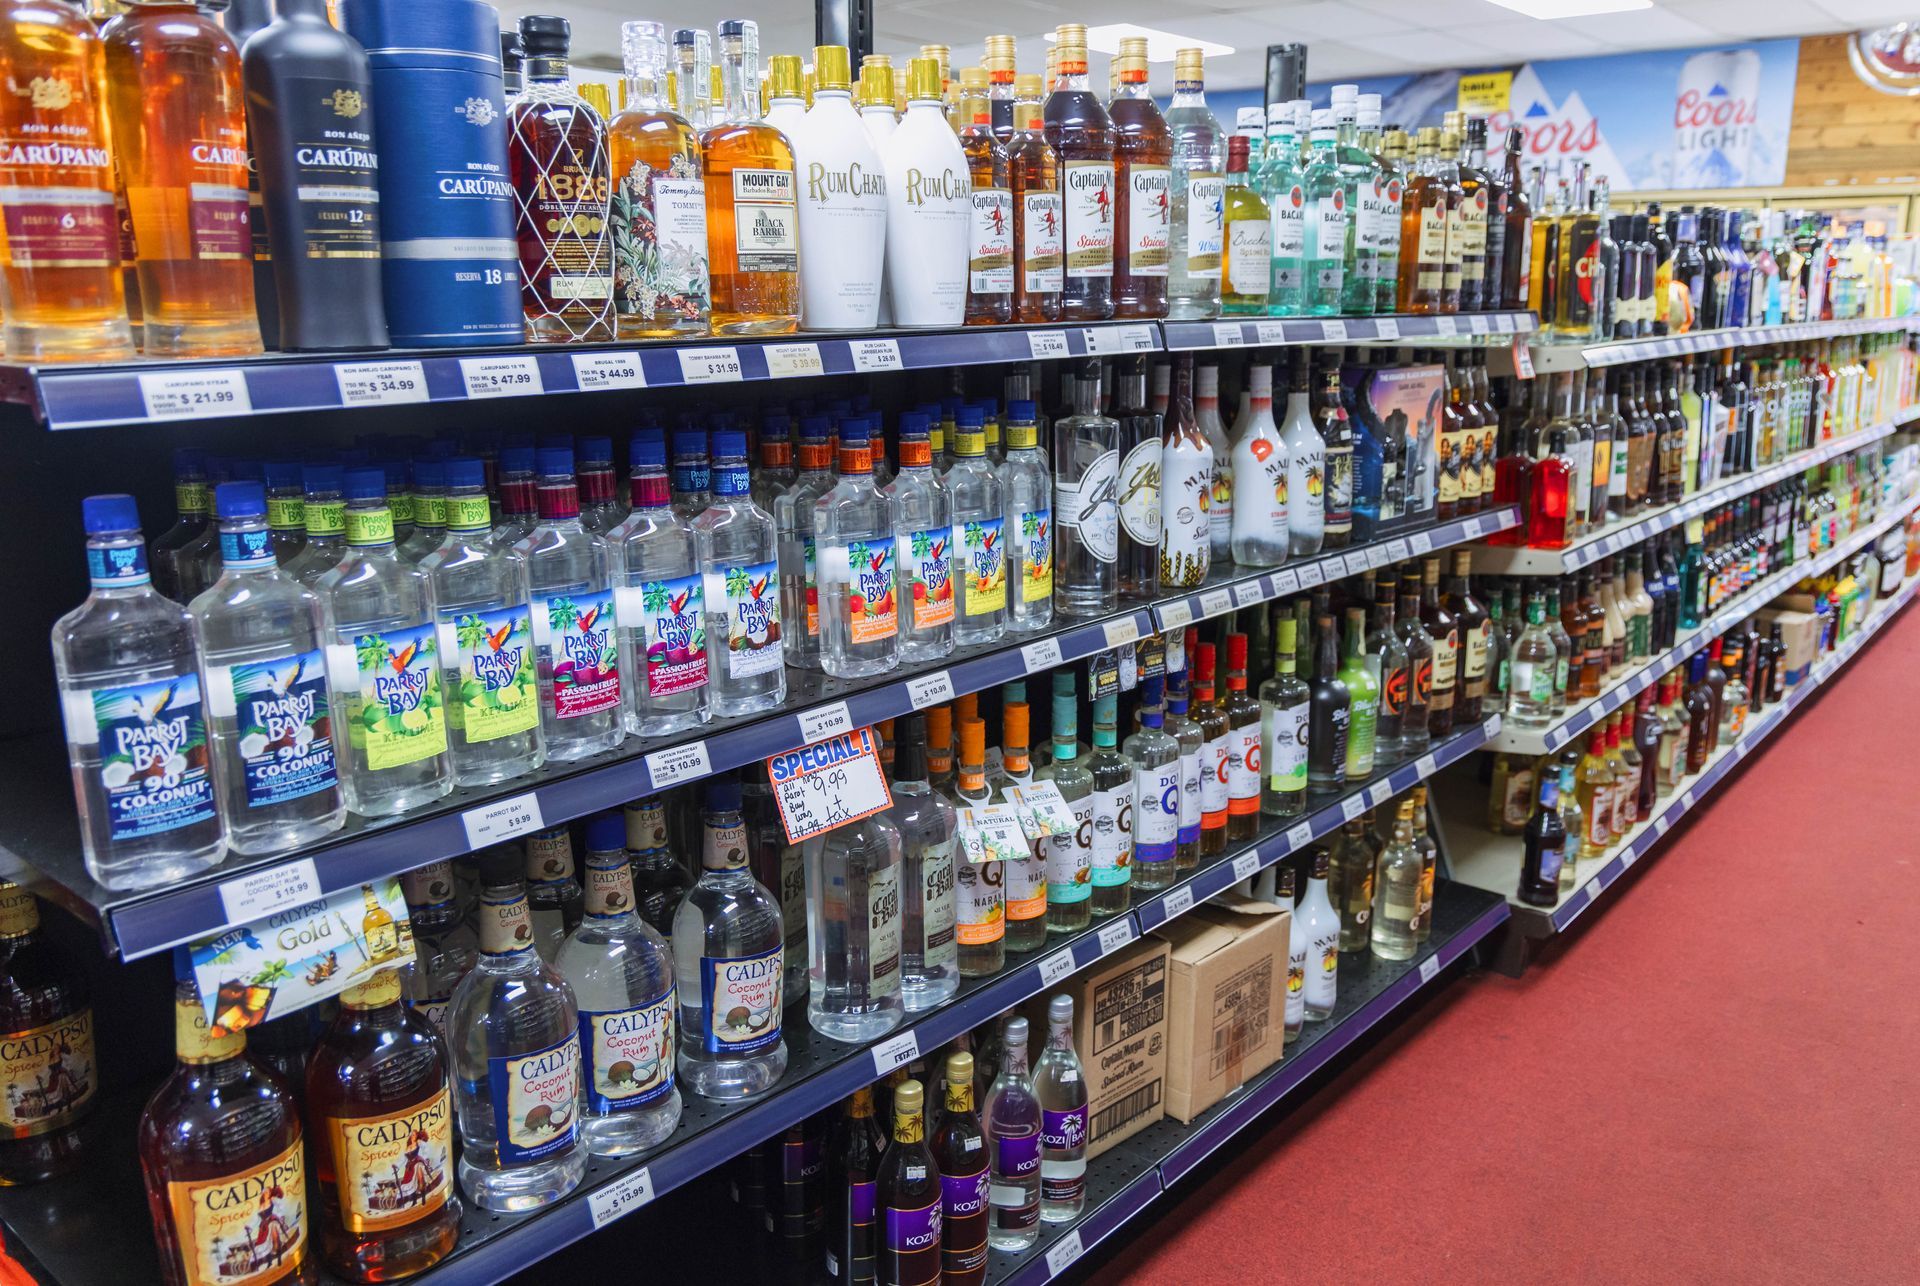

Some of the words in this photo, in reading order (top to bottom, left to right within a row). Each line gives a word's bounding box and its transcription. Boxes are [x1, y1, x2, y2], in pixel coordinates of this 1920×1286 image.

[1673, 88, 1757, 129] Coors
[1678, 126, 1750, 150] LIGHT
[440, 176, 513, 198] CARÚPANO
[535, 174, 609, 201] 1888
[742, 174, 774, 187] MOUNT
[776, 174, 789, 188] GAY
[1070, 170, 1105, 190] Captain
[1134, 174, 1165, 192] Captain
[658, 184, 689, 199] Tommy
[742, 186, 766, 194] Barbados
[1192, 180, 1222, 200] Captain
[972, 194, 998, 210] Captain
[1028, 196, 1050, 212] Captain
[61, 212, 76, 229] 6
[349, 210, 364, 224] 12
[755, 218, 785, 228] BLACK
[752, 227, 788, 237] BARREL
[1077, 234, 1108, 248] Spiced
[979, 244, 1002, 256] Spiced
[1034, 245, 1055, 256] Spiced
[1140, 235, 1167, 248] Spiced
[456, 272, 481, 282] RESERVA
[484, 269, 502, 285] 18
[556, 279, 574, 288] RUM
[1049, 342, 1063, 350] 18.49
[800, 358, 820, 368] 39.99
[882, 354, 896, 362] 26.99
[608, 368, 634, 378] 44.99
[716, 362, 738, 374] 31.99
[381, 380, 414, 391] 34.99
[500, 374, 531, 384] 47.99
[194, 391, 234, 404] 21.99
[460, 500, 488, 516] PARROT
[467, 508, 486, 522] BAY
[361, 513, 392, 530] PARROT
[368, 523, 388, 537] BAY
[974, 548, 1002, 569] PARROT
[1035, 550, 1048, 566] BAY
[922, 556, 950, 580] PARROT
[980, 560, 998, 578] BAY
[860, 568, 892, 592] PARROT
[928, 572, 948, 591] BAY
[867, 584, 887, 603] BAY
[738, 596, 774, 622] PARROT
[926, 598, 950, 610] MANGO
[657, 610, 698, 638] PARROT
[747, 614, 772, 635] BAY
[864, 612, 891, 624] MANGO
[564, 628, 609, 658] PARROT
[666, 627, 694, 652] BAY
[473, 646, 524, 682] PARROT
[574, 646, 606, 671] BAY
[654, 662, 689, 676] PASSION
[689, 659, 706, 670] FRUIT
[376, 666, 430, 708] PARROT
[484, 664, 518, 692] BAY
[561, 682, 598, 696] PASSION
[598, 678, 616, 691] FRUIT
[930, 684, 947, 696] 10.99
[252, 689, 316, 728] PARROT
[388, 686, 424, 718] BAY
[480, 705, 501, 718] KEY
[504, 698, 529, 712] LIME
[828, 707, 845, 716] COCONUT
[267, 709, 308, 742] BAY
[818, 722, 823, 730] $
[824, 716, 844, 728] 10.99
[115, 715, 190, 756] PARROT
[383, 730, 408, 743] KEY
[410, 722, 435, 736] LIME
[132, 737, 181, 772] BAY
[278, 743, 309, 762] 90
[658, 751, 677, 760] CAPTAIN
[678, 746, 698, 756] PAROTBAY
[664, 756, 682, 764] PASSION
[682, 752, 696, 761] FRUIT
[1245, 744, 1260, 774] Q
[256, 750, 330, 778] COCONUT
[670, 764, 676, 774] $
[677, 758, 702, 771] 10.99
[144, 771, 181, 792] 90
[814, 769, 848, 796] 9.99
[120, 780, 206, 810] COCONUT
[1026, 792, 1059, 803] NATURAL
[1160, 784, 1178, 816] Q
[486, 808, 510, 820] PARROT
[510, 804, 522, 815] BAY
[508, 818, 514, 827] $
[515, 814, 531, 825] 9.99
[826, 806, 853, 830] tax
[976, 816, 1016, 826] NATURAL
[1116, 804, 1132, 834] Q
[1075, 820, 1093, 850] Q
[970, 842, 980, 852] Q
[244, 875, 273, 888] PARROT
[274, 870, 289, 879] BAY
[592, 868, 630, 884] CALYPSO
[926, 860, 954, 889] Coral
[247, 881, 282, 896] COCONUT
[284, 875, 300, 884] RUM
[284, 882, 308, 896] 15.99
[593, 880, 618, 892] Coconut
[619, 879, 633, 891] Rum
[872, 886, 898, 916] Coral
[934, 904, 950, 914] SILVER
[268, 900, 328, 930] CALYPSO
[500, 914, 526, 928] Coconut
[211, 930, 244, 954] NEW
[276, 916, 333, 952] Gold
[879, 930, 896, 943] SILVER
[727, 977, 772, 996] Coconut
[740, 992, 765, 1009] Rum
[1, 1016, 89, 1061] CALYPSO
[606, 1027, 656, 1050] Coconut
[622, 1044, 650, 1062] Rum
[4, 1053, 45, 1077] Spiced
[524, 1066, 571, 1095] Coconut
[540, 1084, 566, 1104] Rum
[357, 1098, 447, 1148] CALYPSO
[360, 1144, 402, 1168] Spiced
[430, 1122, 448, 1142] Rum
[1041, 1134, 1066, 1145] KOZI
[1072, 1129, 1086, 1142] BAY
[1017, 1158, 1039, 1172] KOZI
[206, 1147, 302, 1212] CALYPSO
[596, 1188, 616, 1200] CALYPSO
[616, 1182, 626, 1190] RUM
[626, 1172, 646, 1185] COCONUT
[612, 1200, 618, 1208] $
[620, 1186, 644, 1204] 13.99
[954, 1200, 980, 1212] KOZI
[208, 1205, 255, 1237] Spiced
[906, 1232, 934, 1247] KOZI
